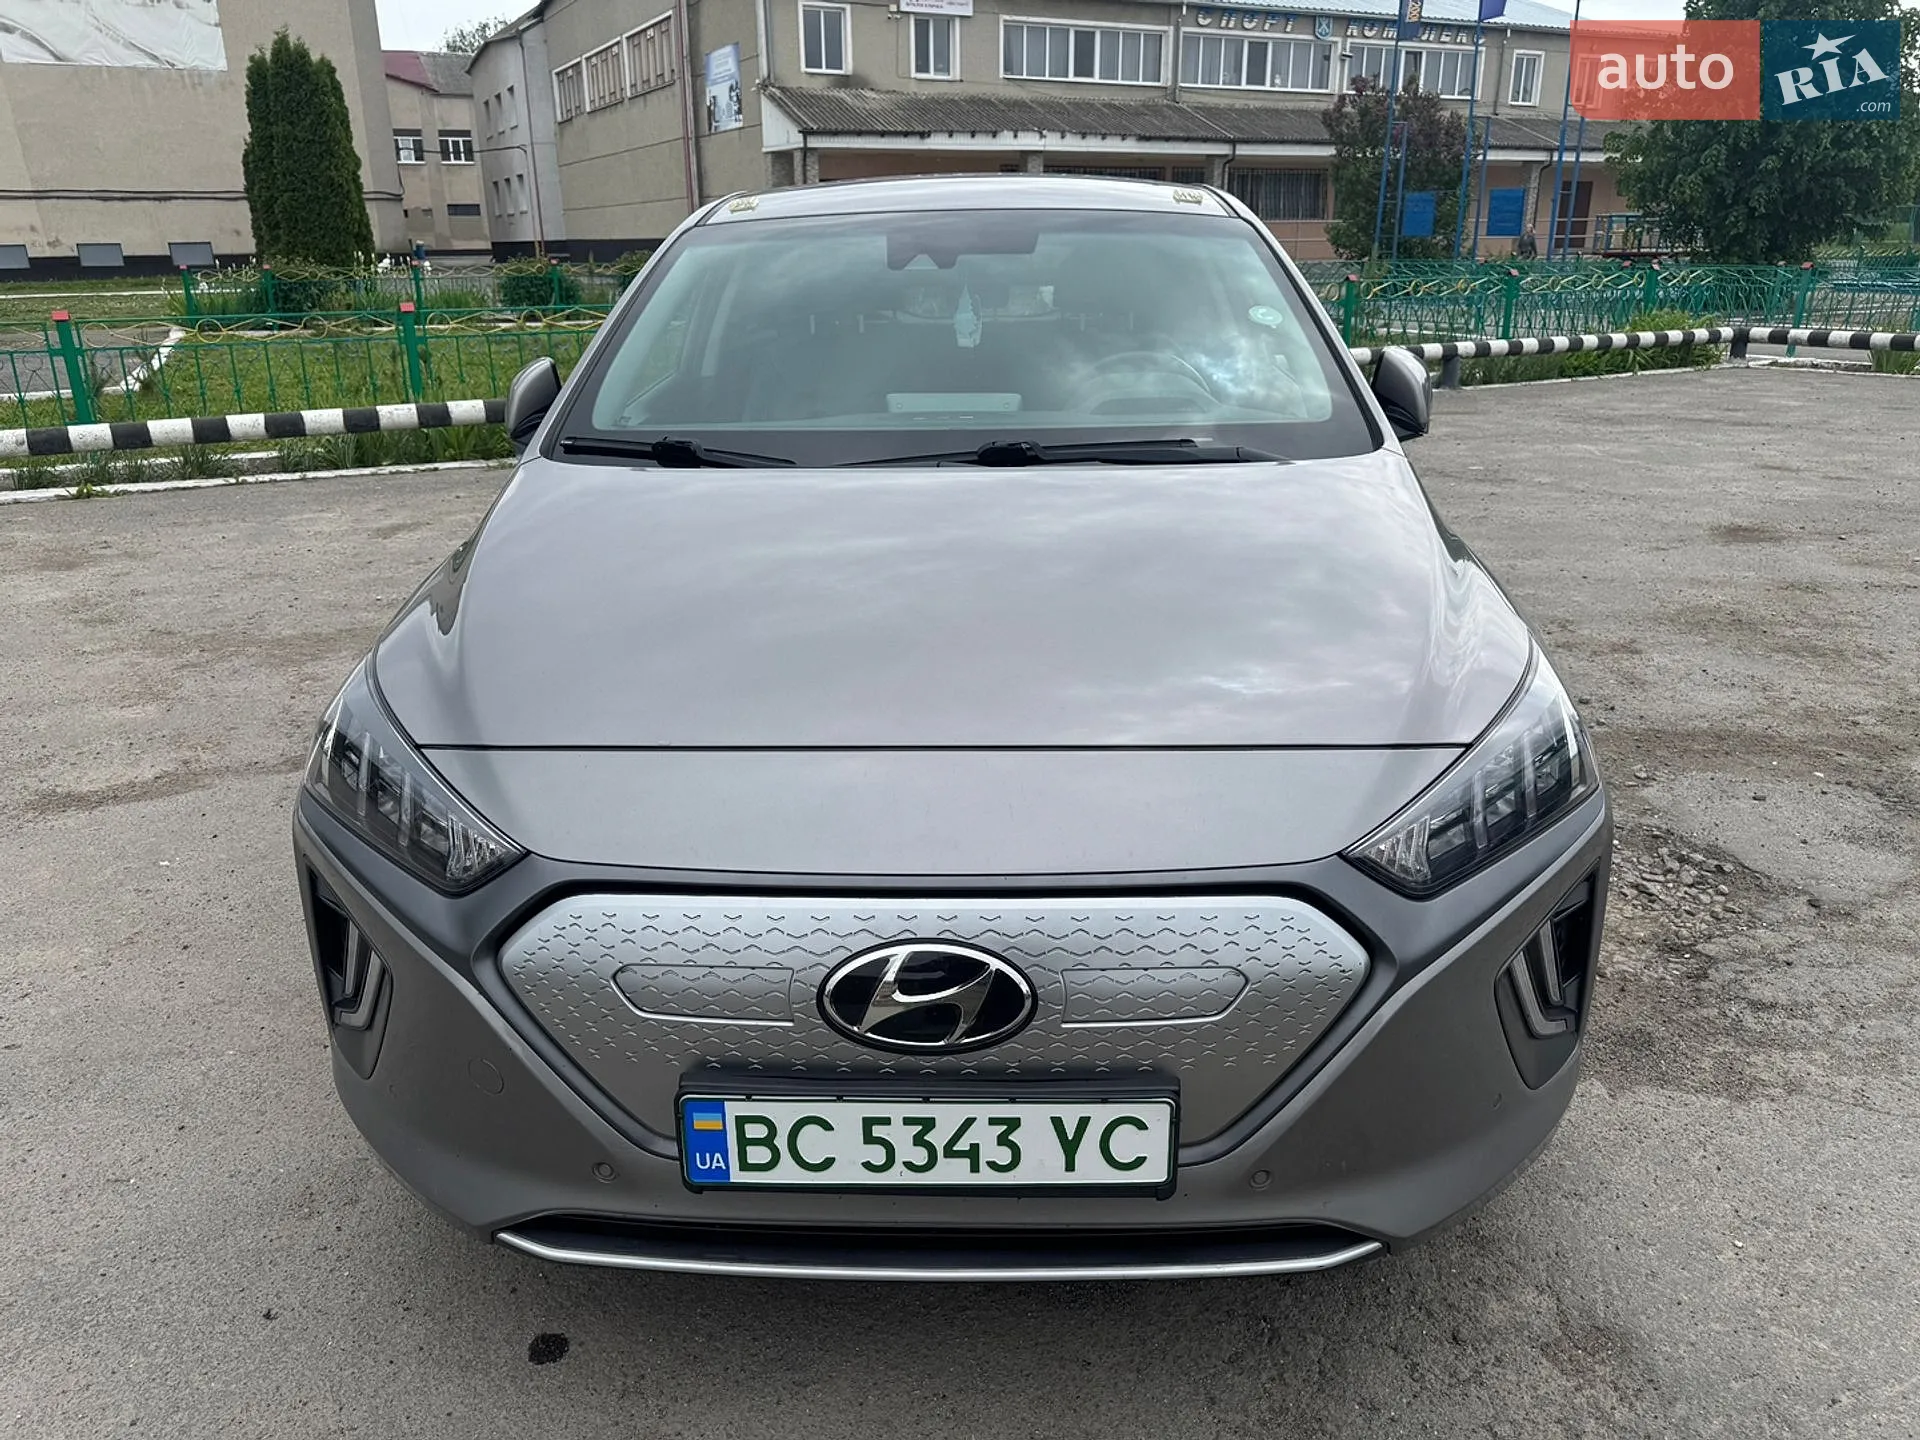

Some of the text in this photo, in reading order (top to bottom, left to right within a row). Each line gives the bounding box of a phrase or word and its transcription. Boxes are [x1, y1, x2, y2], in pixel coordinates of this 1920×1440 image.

[1196, 7, 1487, 45] СПОРТ КОМЛЕКС
[695, 1152, 726, 1170] UA
[734, 1115, 1149, 1174] BC 5343 YC
